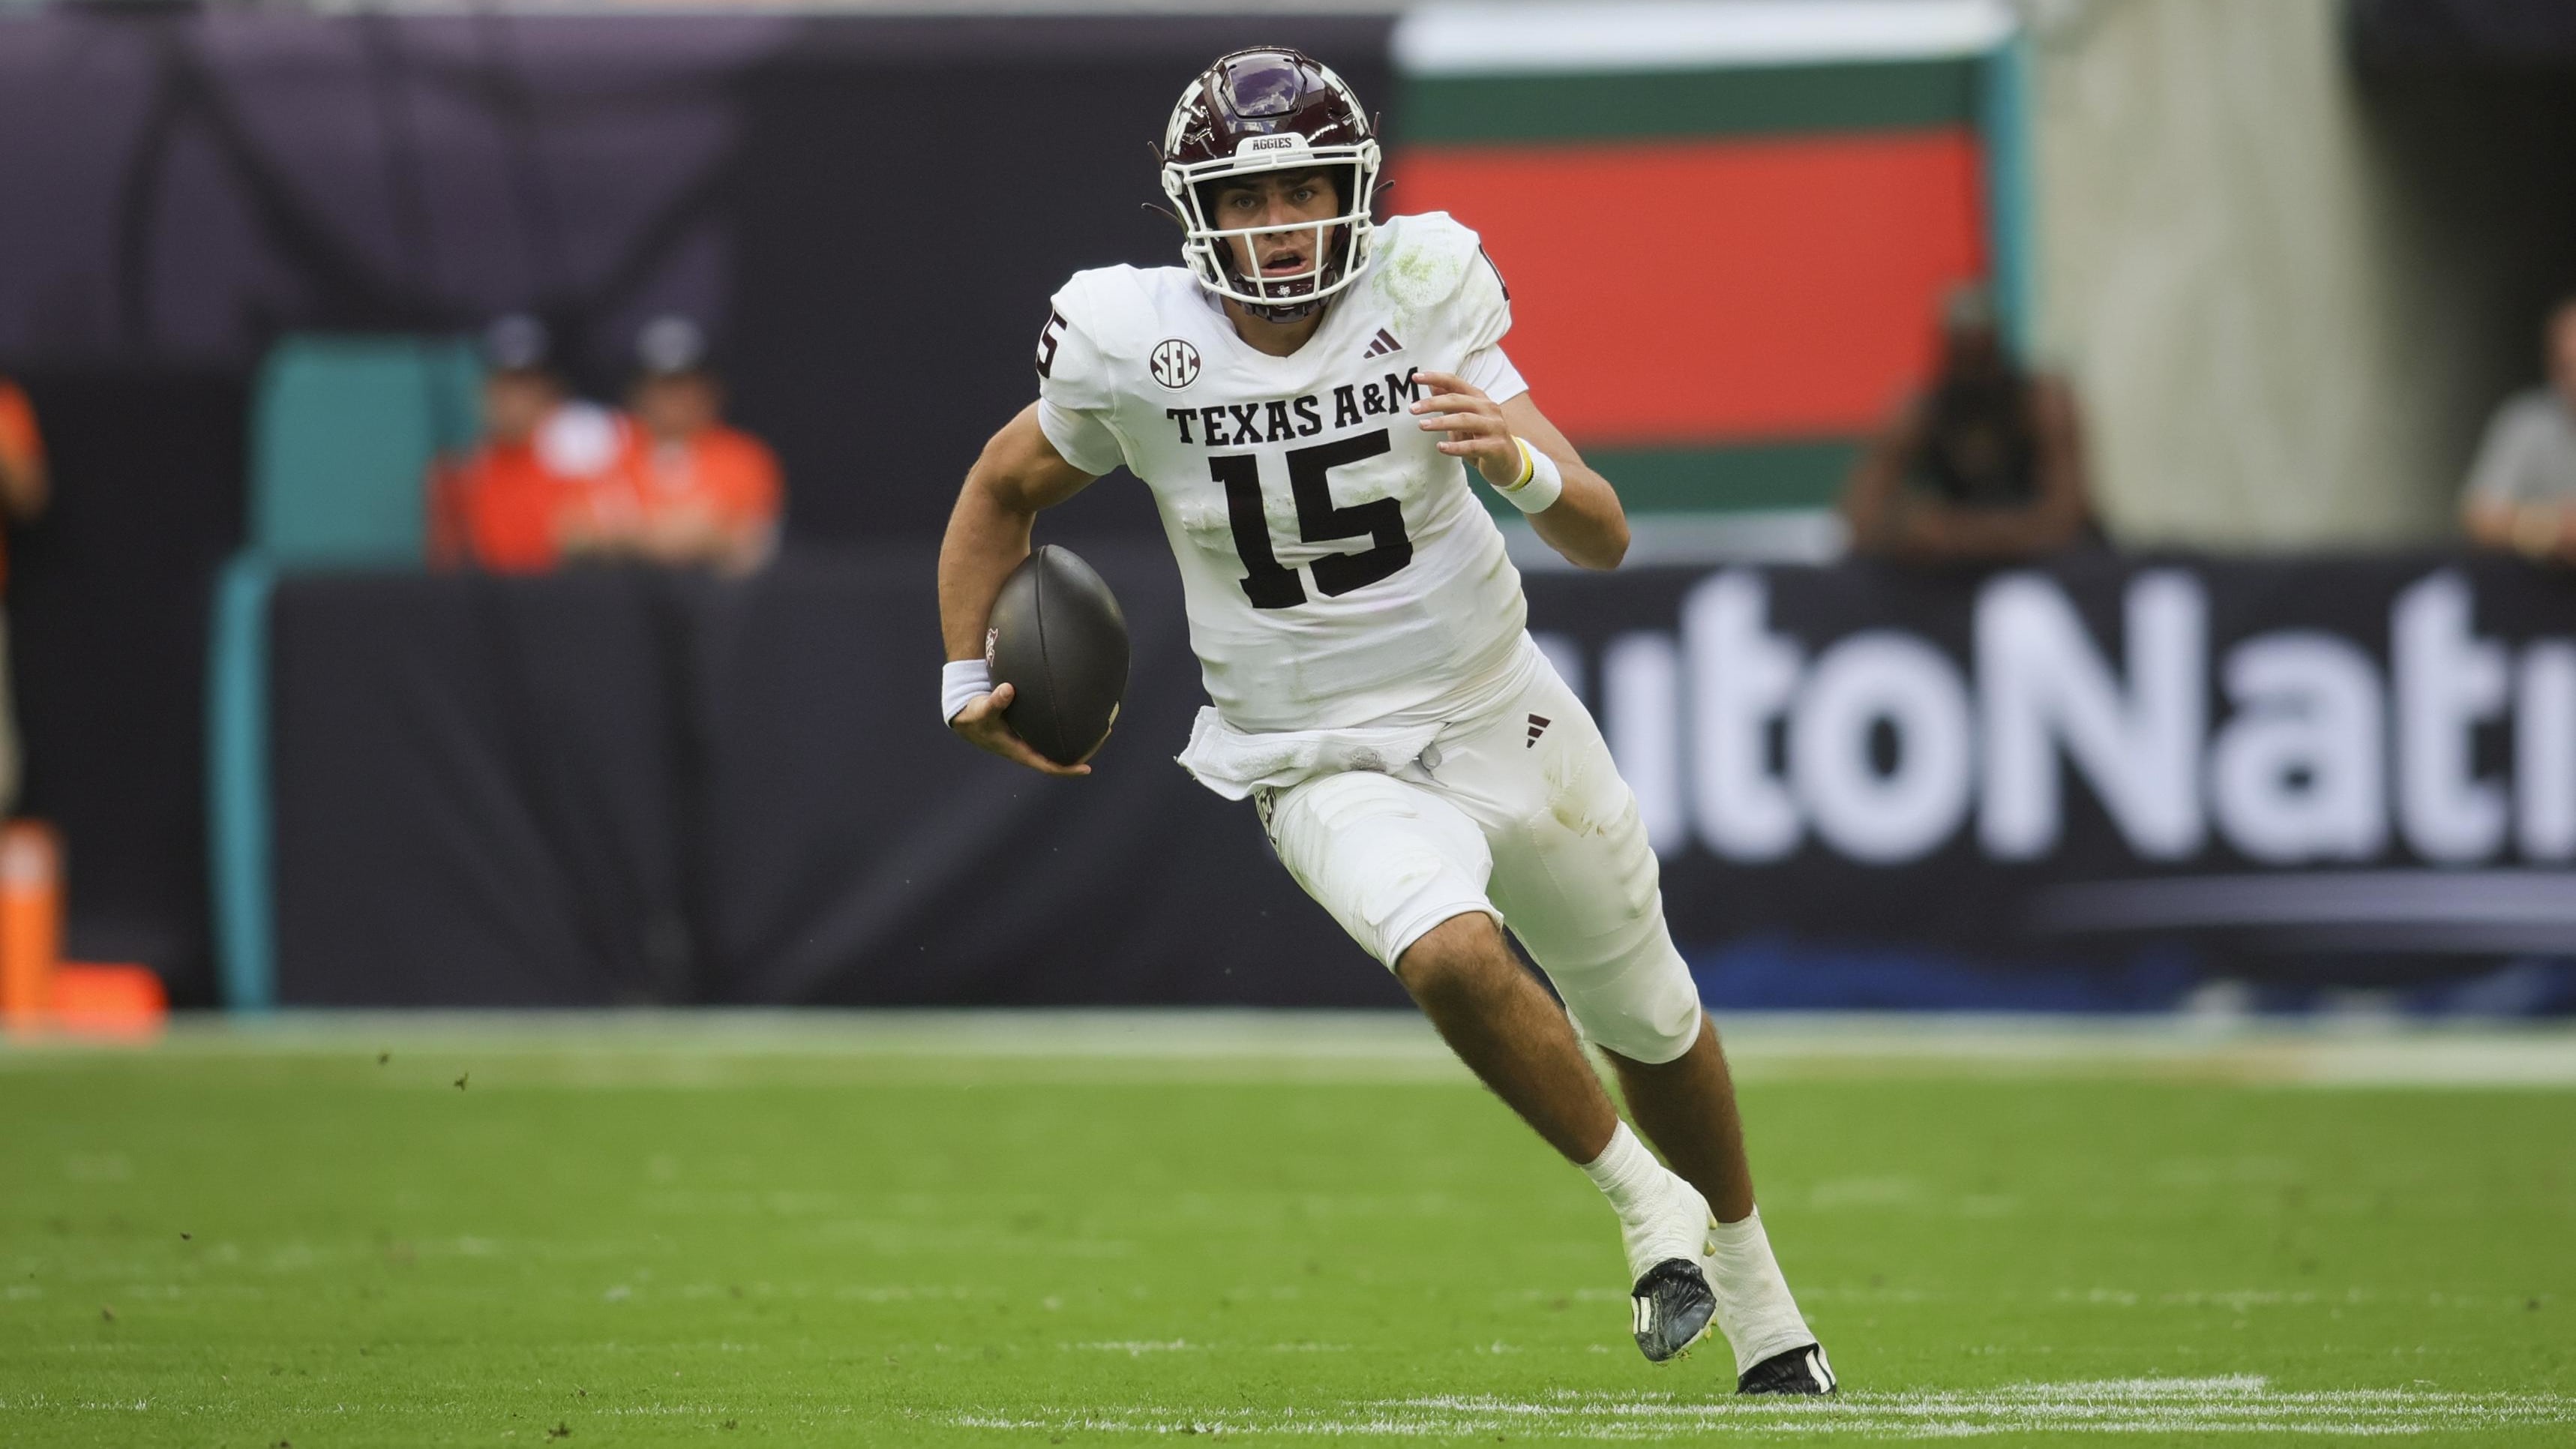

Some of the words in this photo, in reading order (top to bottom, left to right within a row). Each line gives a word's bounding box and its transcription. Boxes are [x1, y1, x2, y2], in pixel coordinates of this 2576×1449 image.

[1252, 137, 1292, 151] AGGIES
[1152, 341, 1198, 387] SEC
[1166, 395, 1322, 446] TEXAS
[1333, 366, 1420, 428] A&M
[1208, 428, 1413, 609] 15
